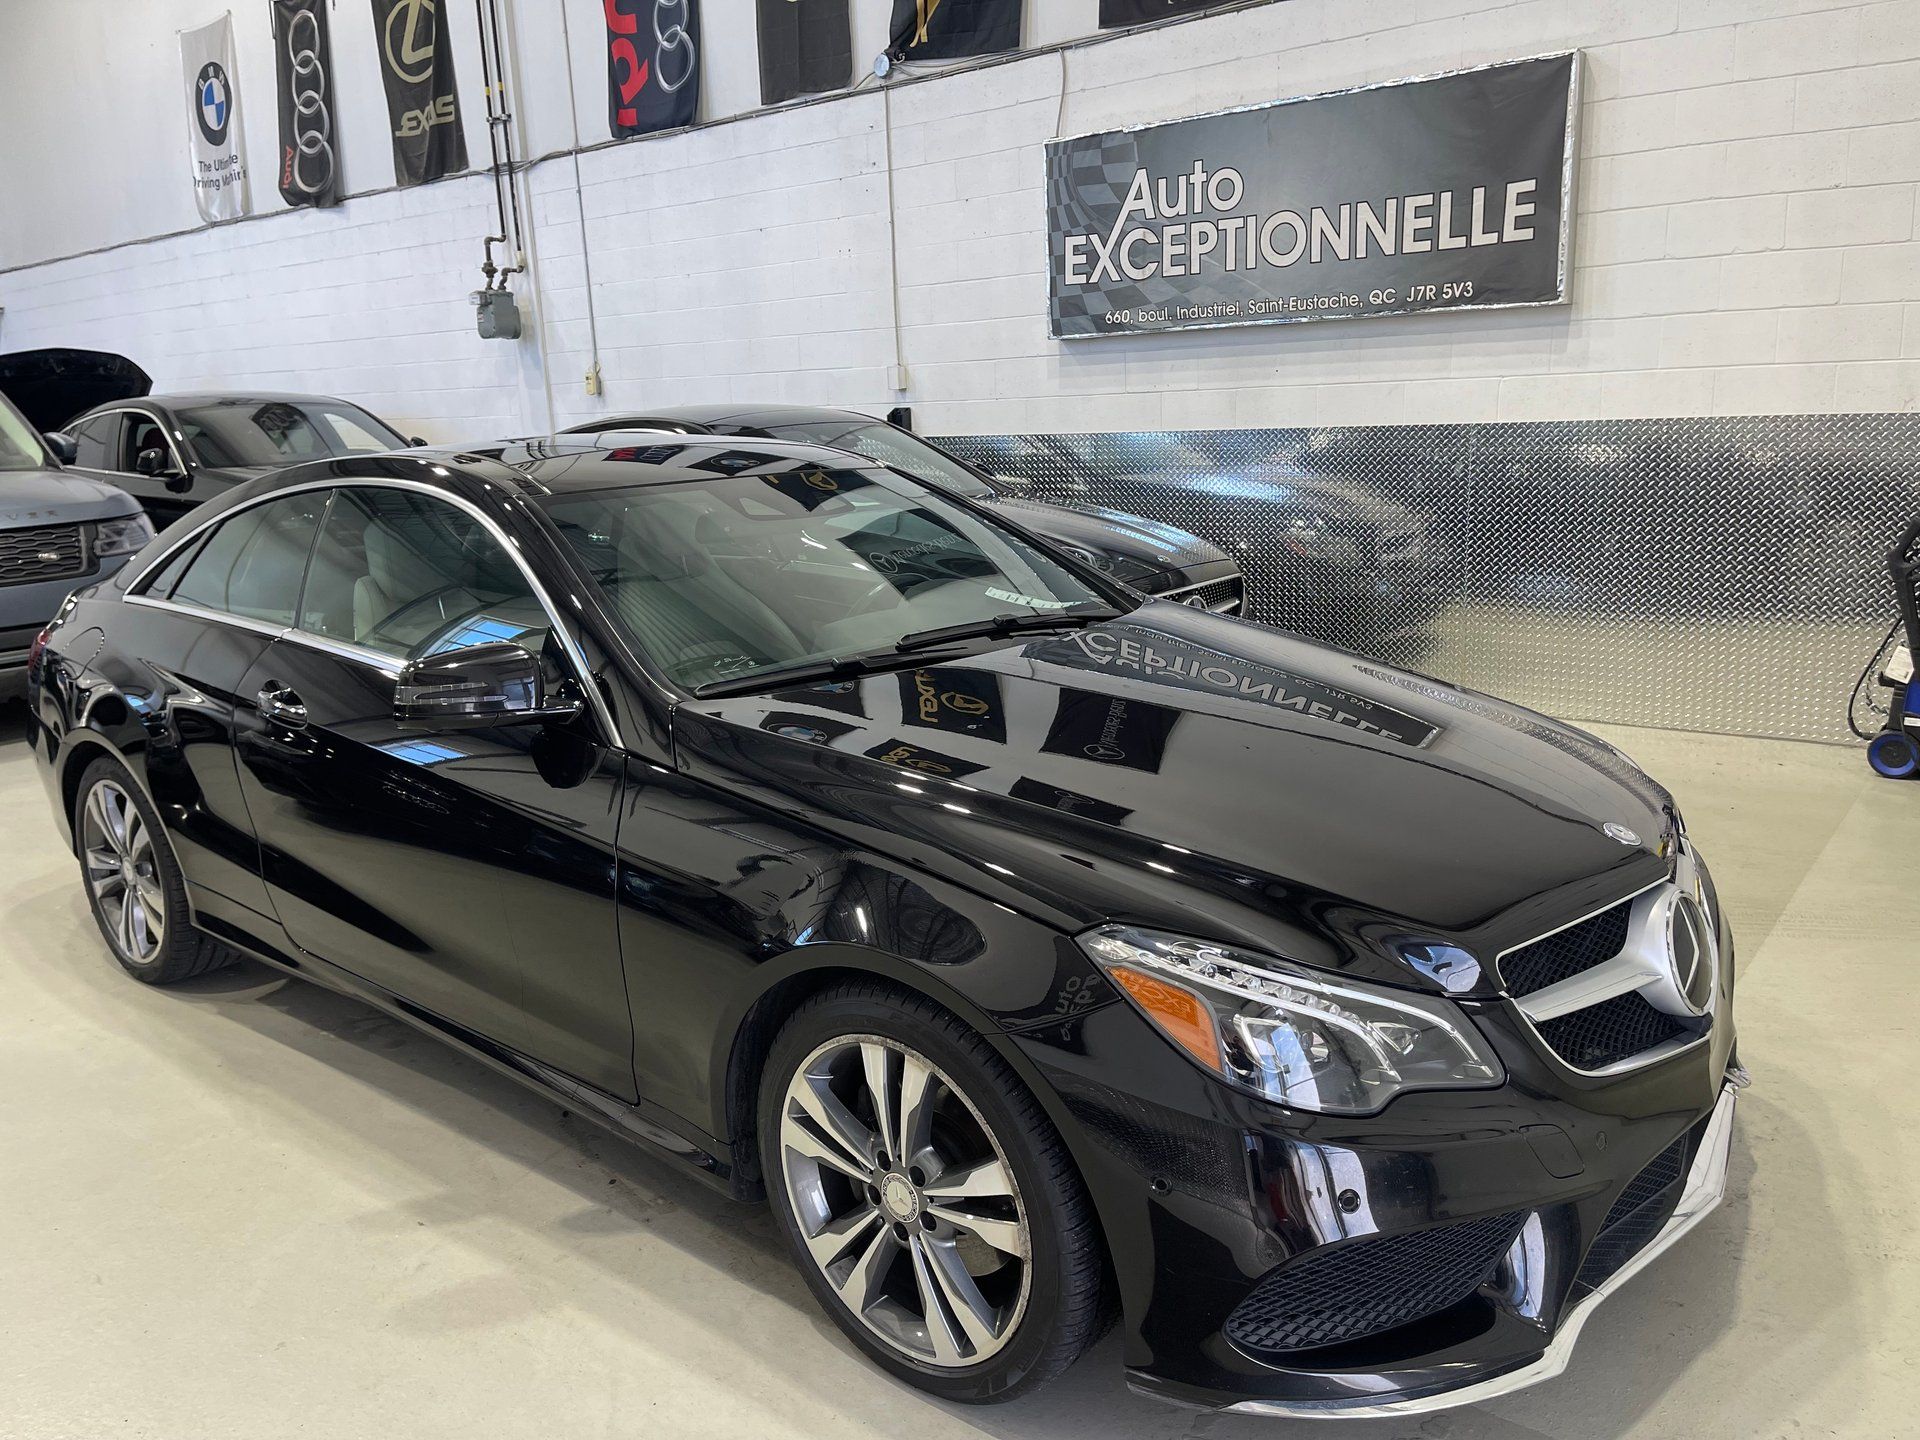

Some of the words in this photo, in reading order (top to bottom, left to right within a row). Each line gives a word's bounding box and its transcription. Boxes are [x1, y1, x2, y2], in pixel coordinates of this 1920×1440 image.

[604, 0, 649, 127] udi
[198, 160, 212, 173] The
[282, 144, 294, 189] Audi
[1114, 158, 1245, 232] Auto
[1063, 178, 1538, 287] EXCEPTIONNELLE
[1105, 309, 1134, 325] 660,
[1138, 306, 1172, 323] boul.
[1176, 301, 1244, 320] Industriel,
[1247, 292, 1364, 315] Saint-Eustache,
[1368, 288, 1397, 306] QC
[1406, 284, 1437, 303] J7R
[1441, 281, 1474, 300] 5V3
